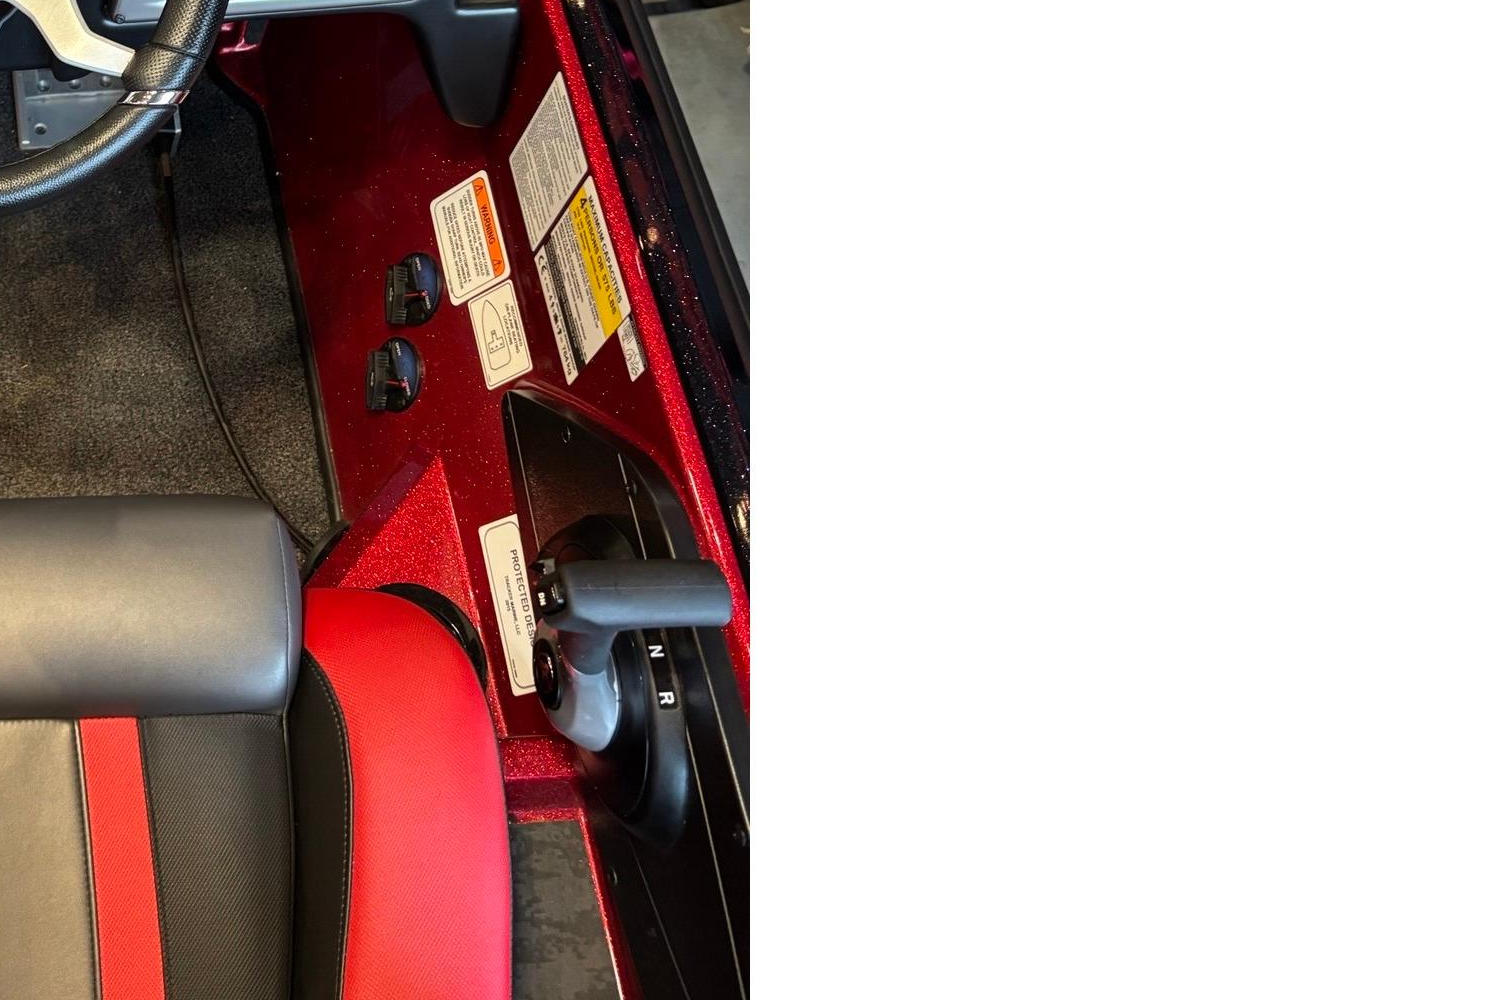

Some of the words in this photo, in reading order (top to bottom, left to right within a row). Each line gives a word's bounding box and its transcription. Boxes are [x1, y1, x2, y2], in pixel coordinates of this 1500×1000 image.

[480, 205, 496, 245] WARNING
[582, 206, 599, 256] PERSONS
[588, 194, 604, 243] MAXIMUM
[601, 241, 622, 304] CAPACITIES
[509, 548, 530, 612] PROTECTED
[648, 644, 665, 658] N
[658, 691, 675, 705] R
